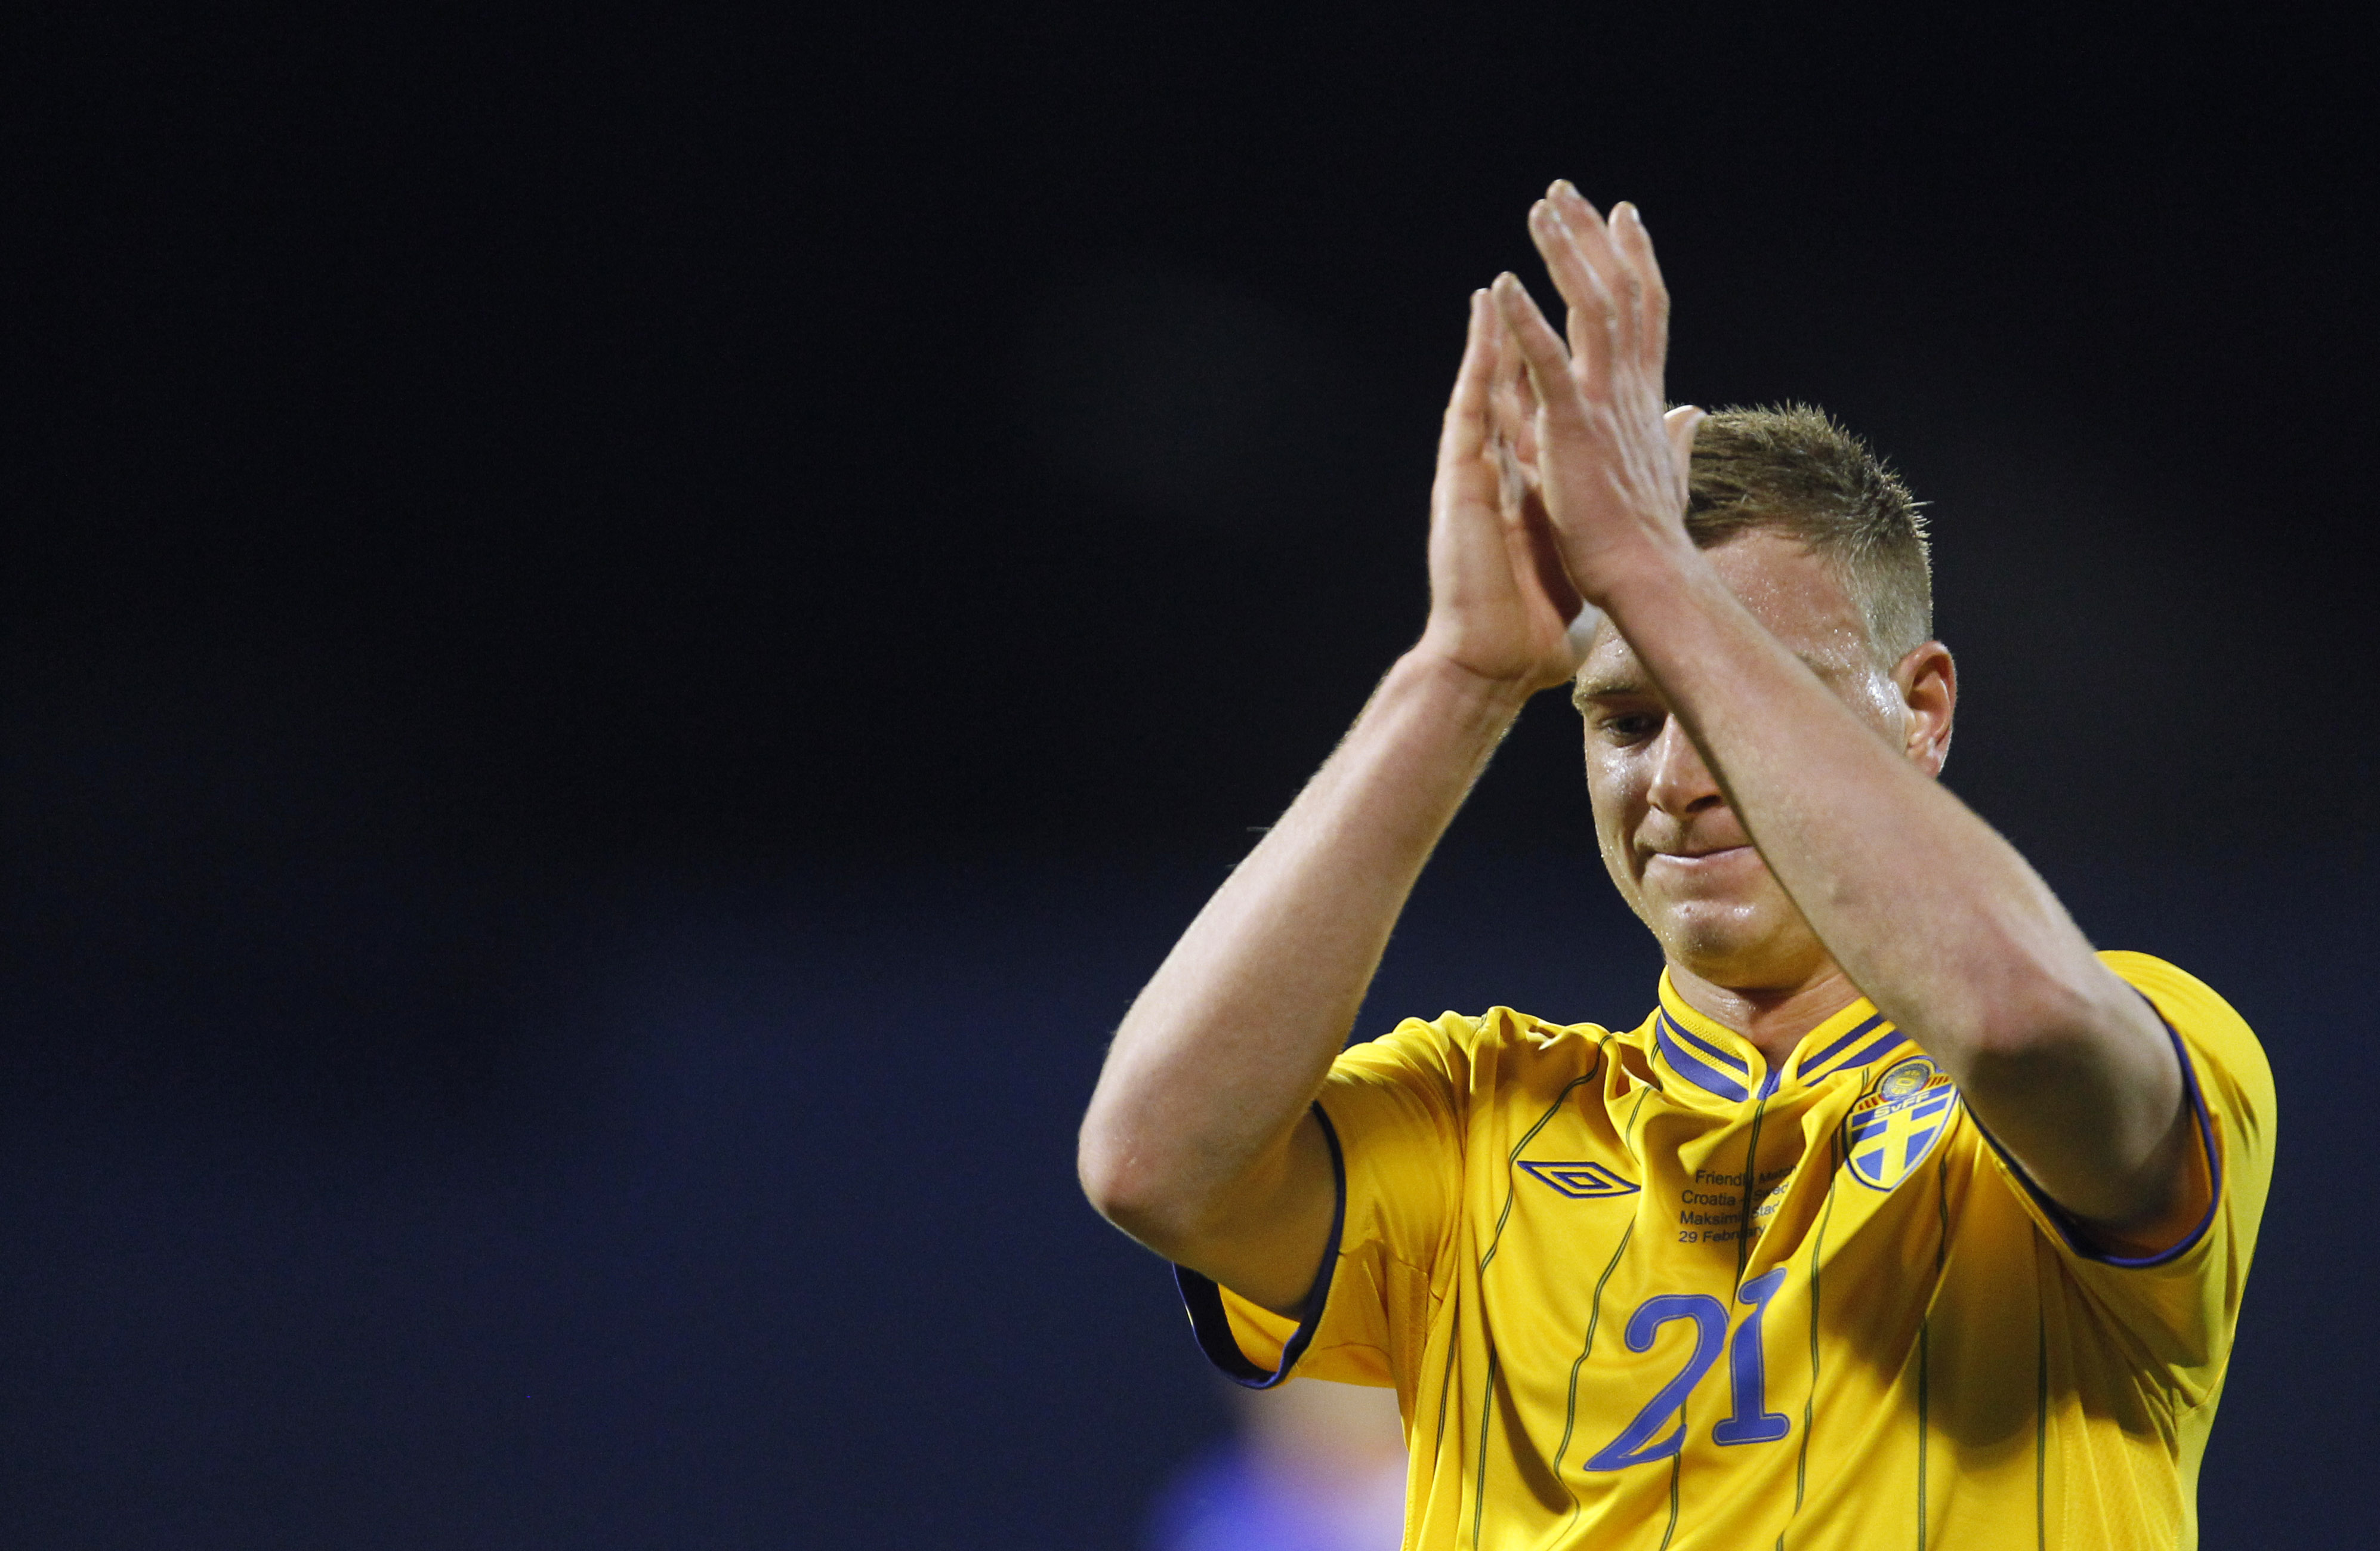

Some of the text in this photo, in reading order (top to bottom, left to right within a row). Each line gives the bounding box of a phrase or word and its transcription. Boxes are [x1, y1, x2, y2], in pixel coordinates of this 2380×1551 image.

[1681, 1189, 1736, 1206] Croatia
[1678, 1230, 1698, 1243] 29
[1583, 1266, 1791, 1472] 21
